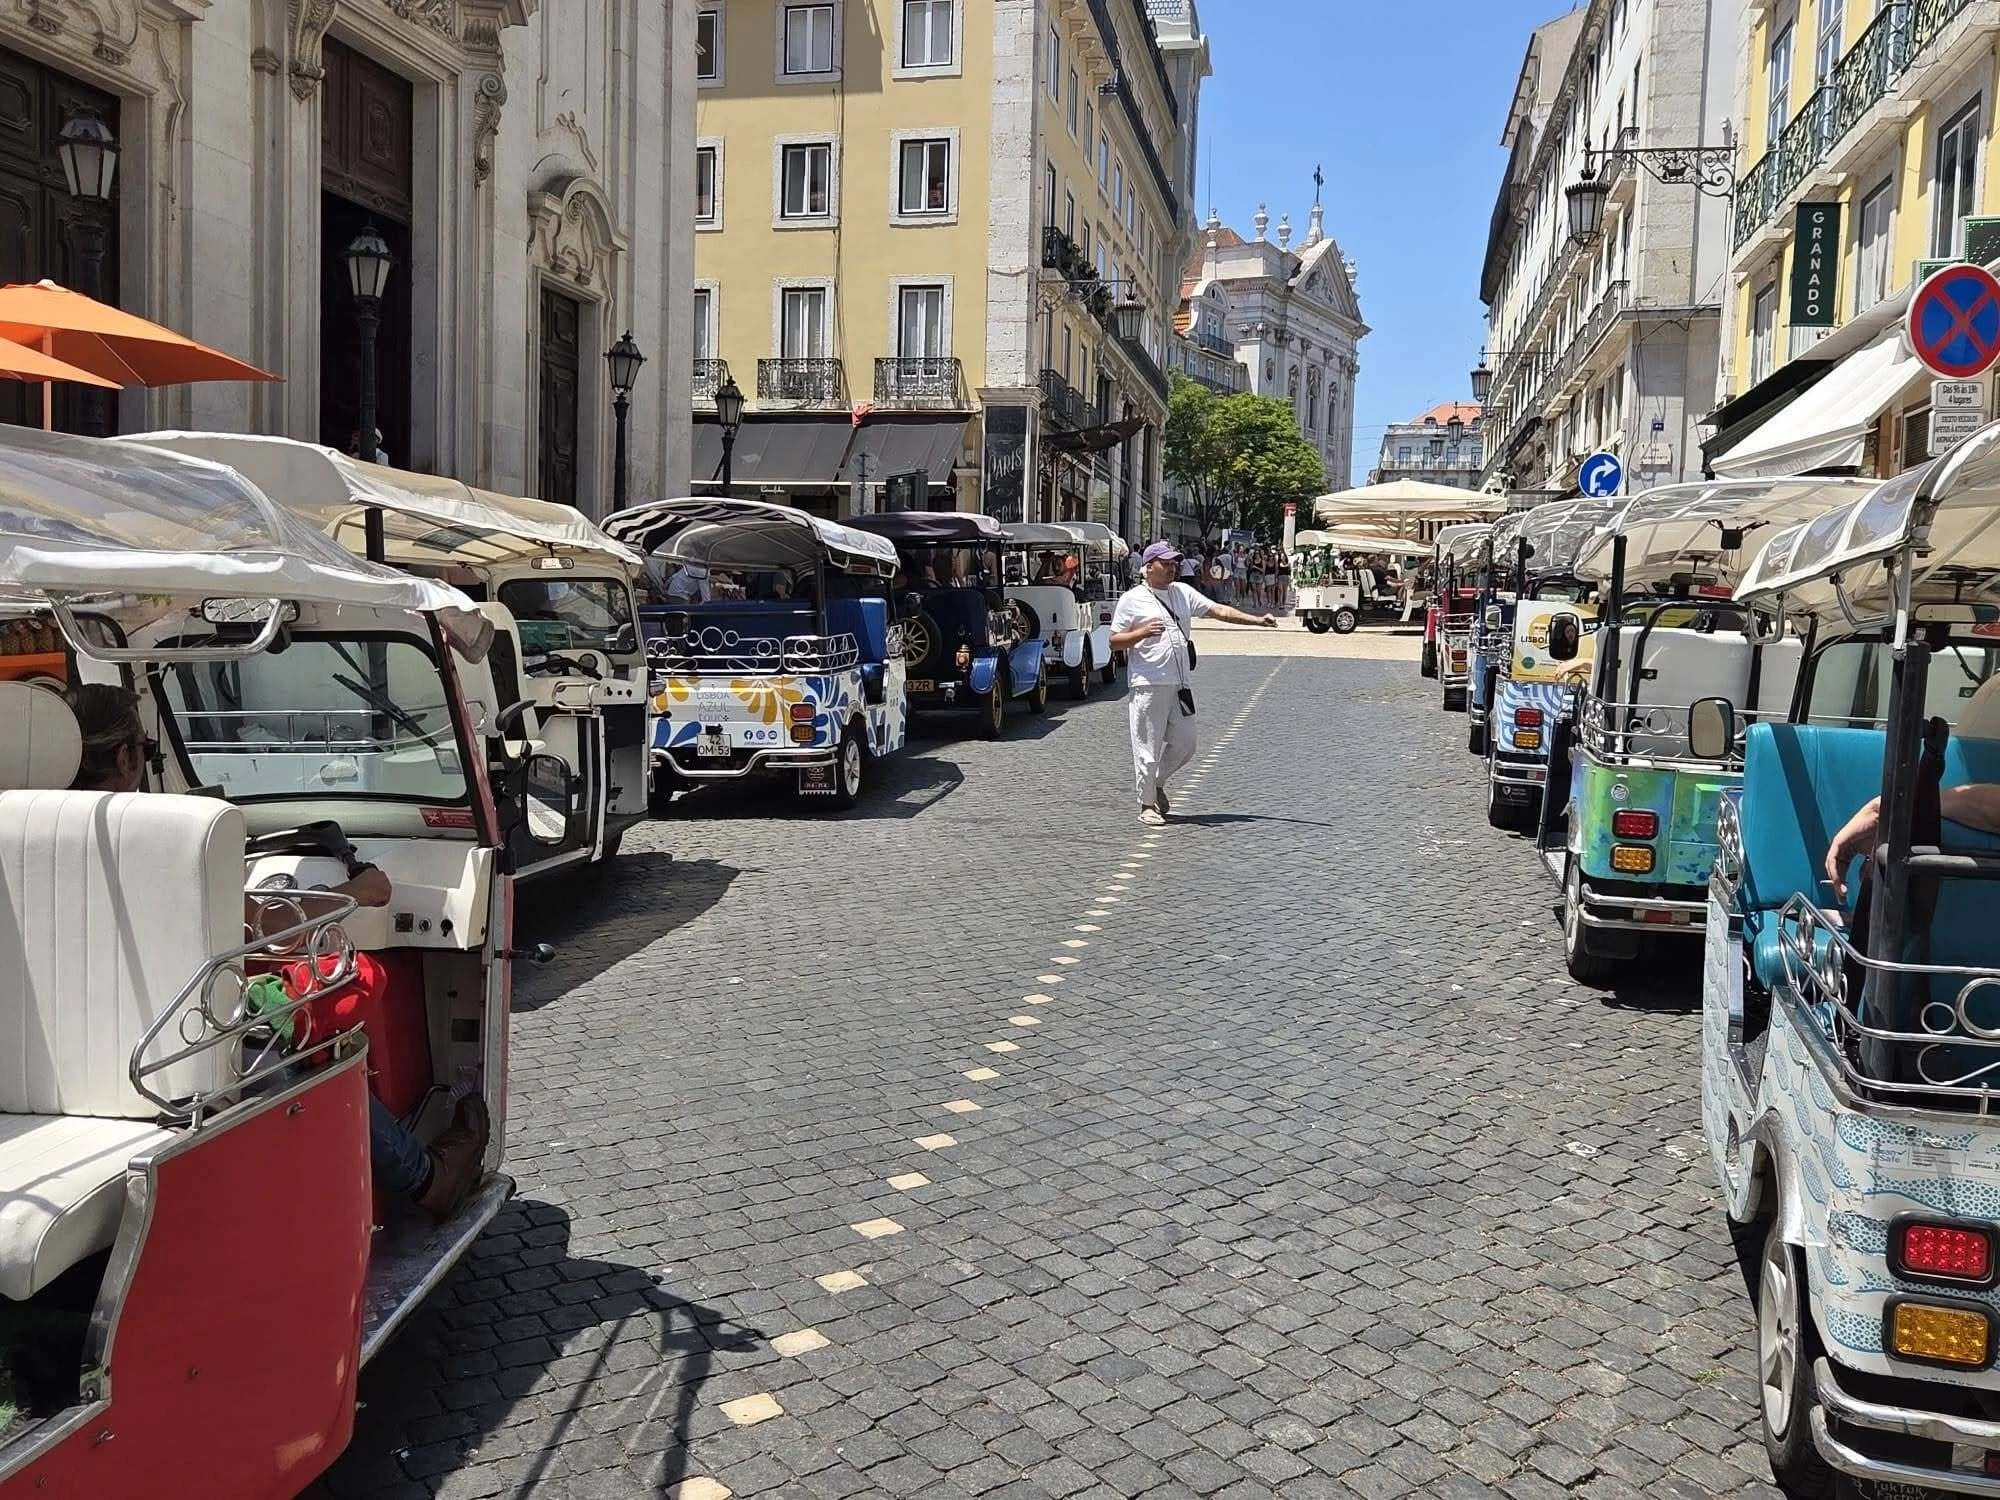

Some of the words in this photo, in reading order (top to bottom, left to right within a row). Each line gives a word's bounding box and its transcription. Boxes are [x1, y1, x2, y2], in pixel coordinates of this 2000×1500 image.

[1807, 212, 1825, 316] GRANADO
[986, 447, 1023, 490] PARIS
[1520, 635, 1547, 644] LISBO
[698, 701, 730, 712] AZUL
[709, 735, 722, 745] 42
